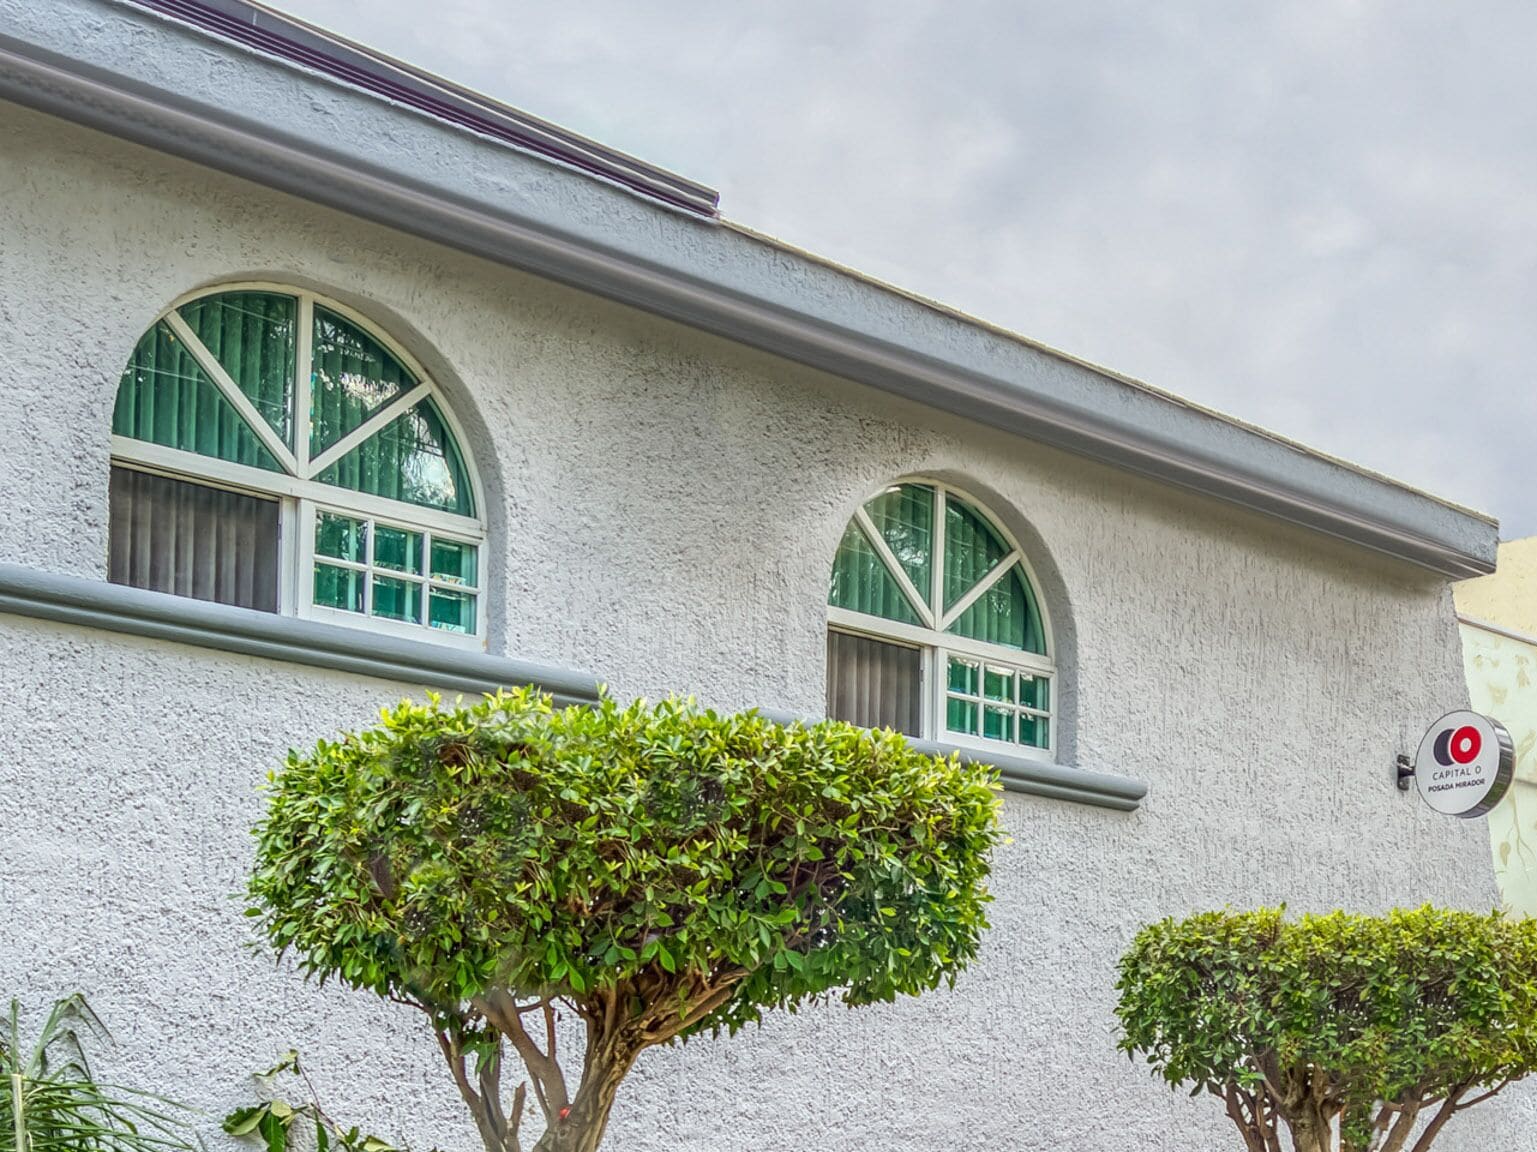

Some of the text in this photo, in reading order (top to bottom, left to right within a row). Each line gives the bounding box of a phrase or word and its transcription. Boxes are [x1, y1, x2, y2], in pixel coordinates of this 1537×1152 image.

[1432, 765, 1482, 780] CAPITAL O
[1428, 778, 1485, 793] POSADA MIRADOR
